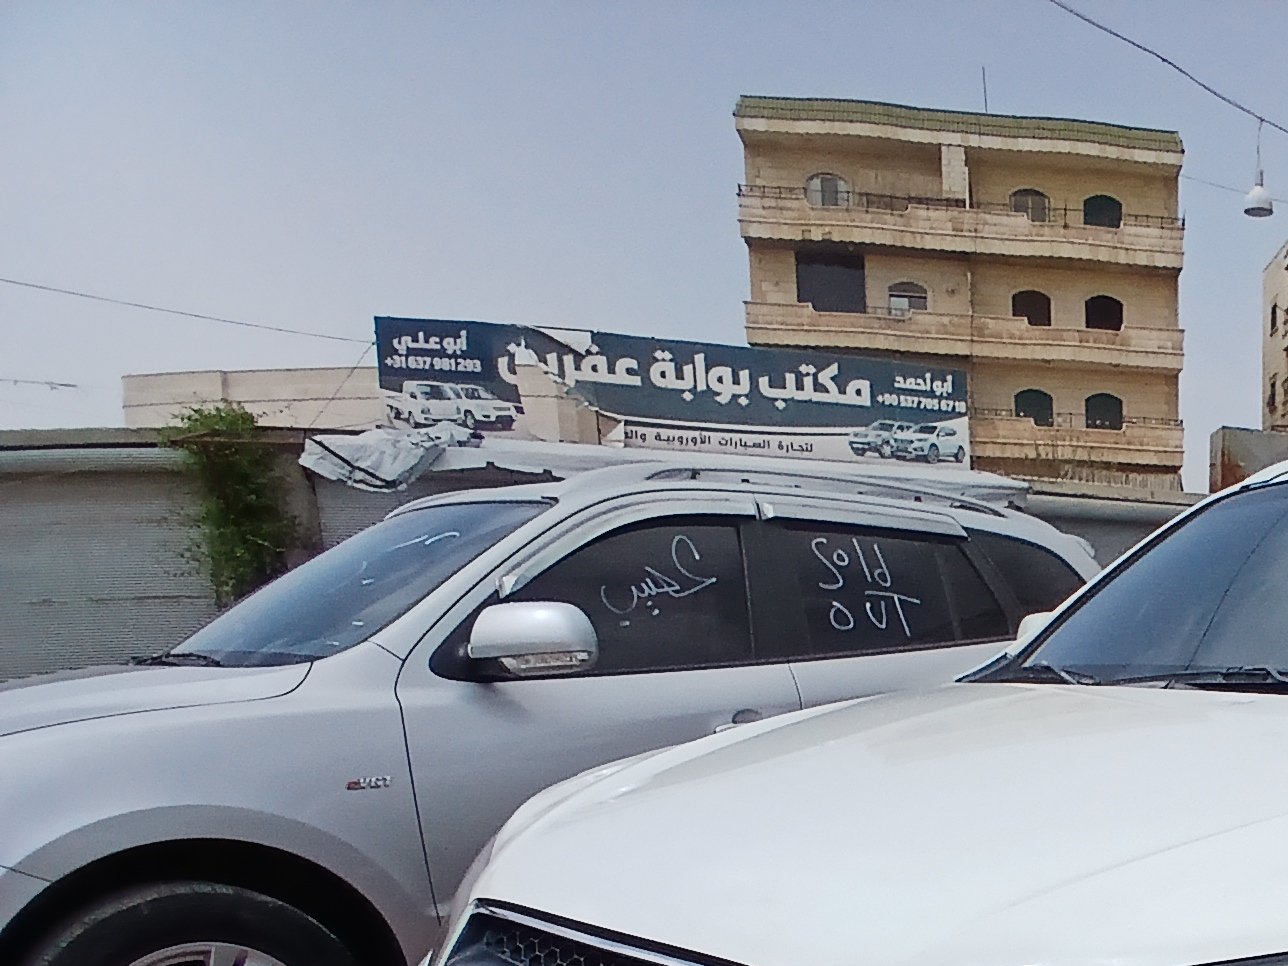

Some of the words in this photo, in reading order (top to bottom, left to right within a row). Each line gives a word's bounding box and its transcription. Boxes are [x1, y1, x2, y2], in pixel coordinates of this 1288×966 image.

[393, 331, 441, 355] علي
[650, 350, 750, 406] بوابة
[758, 362, 871, 410] مكتب
[718, 436, 771, 450] السيارات
